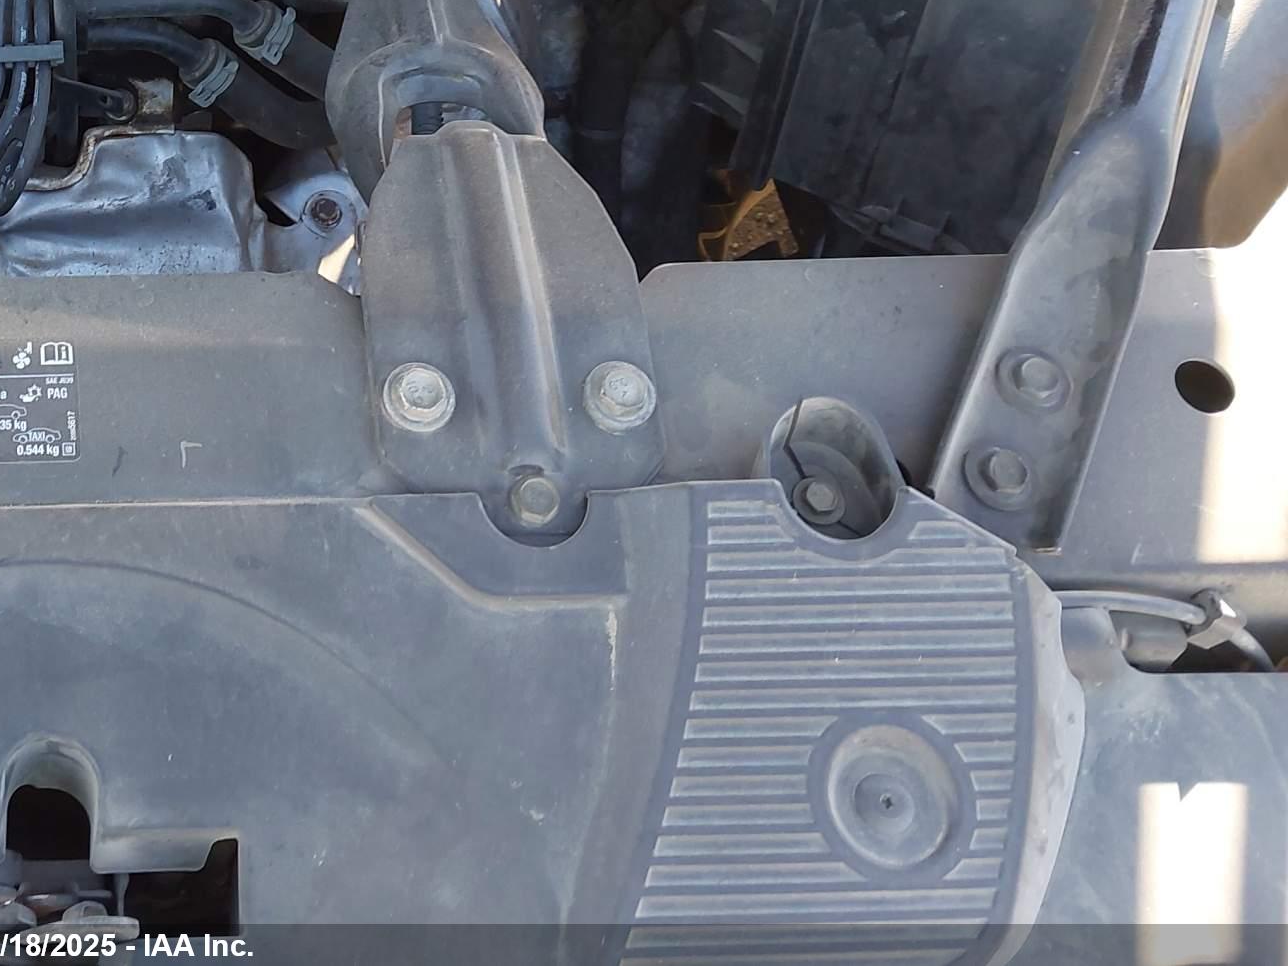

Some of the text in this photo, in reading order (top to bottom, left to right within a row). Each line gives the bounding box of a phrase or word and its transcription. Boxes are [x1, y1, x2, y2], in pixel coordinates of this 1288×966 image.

[47, 387, 68, 400] PAG
[13, 419, 27, 432] kg
[28, 431, 46, 440] TAXI
[16, 443, 60, 457] 0.544 kg
